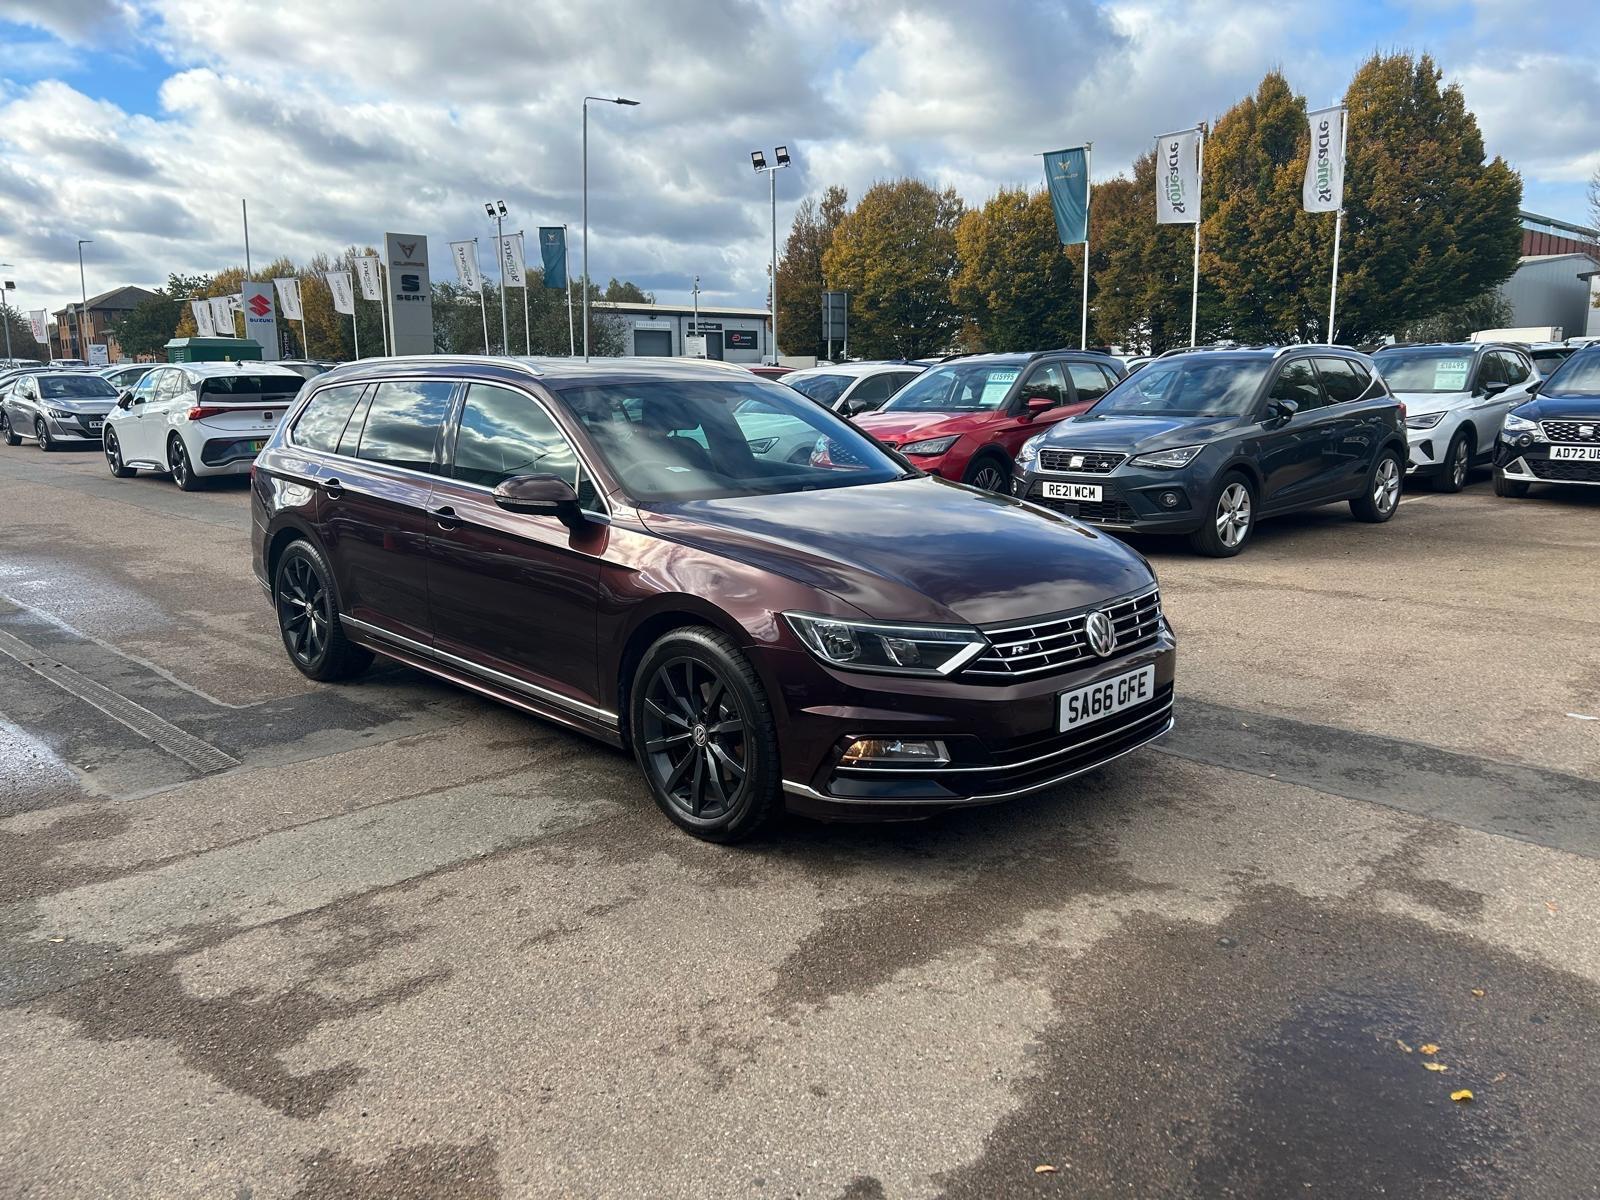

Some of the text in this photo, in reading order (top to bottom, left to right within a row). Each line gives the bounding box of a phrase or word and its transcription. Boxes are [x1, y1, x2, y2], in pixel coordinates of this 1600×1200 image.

[1555, 448, 1586, 458] AD72
[1049, 484, 1096, 499] RE21 WCM
[1068, 671, 1148, 724] SA66 GFE
